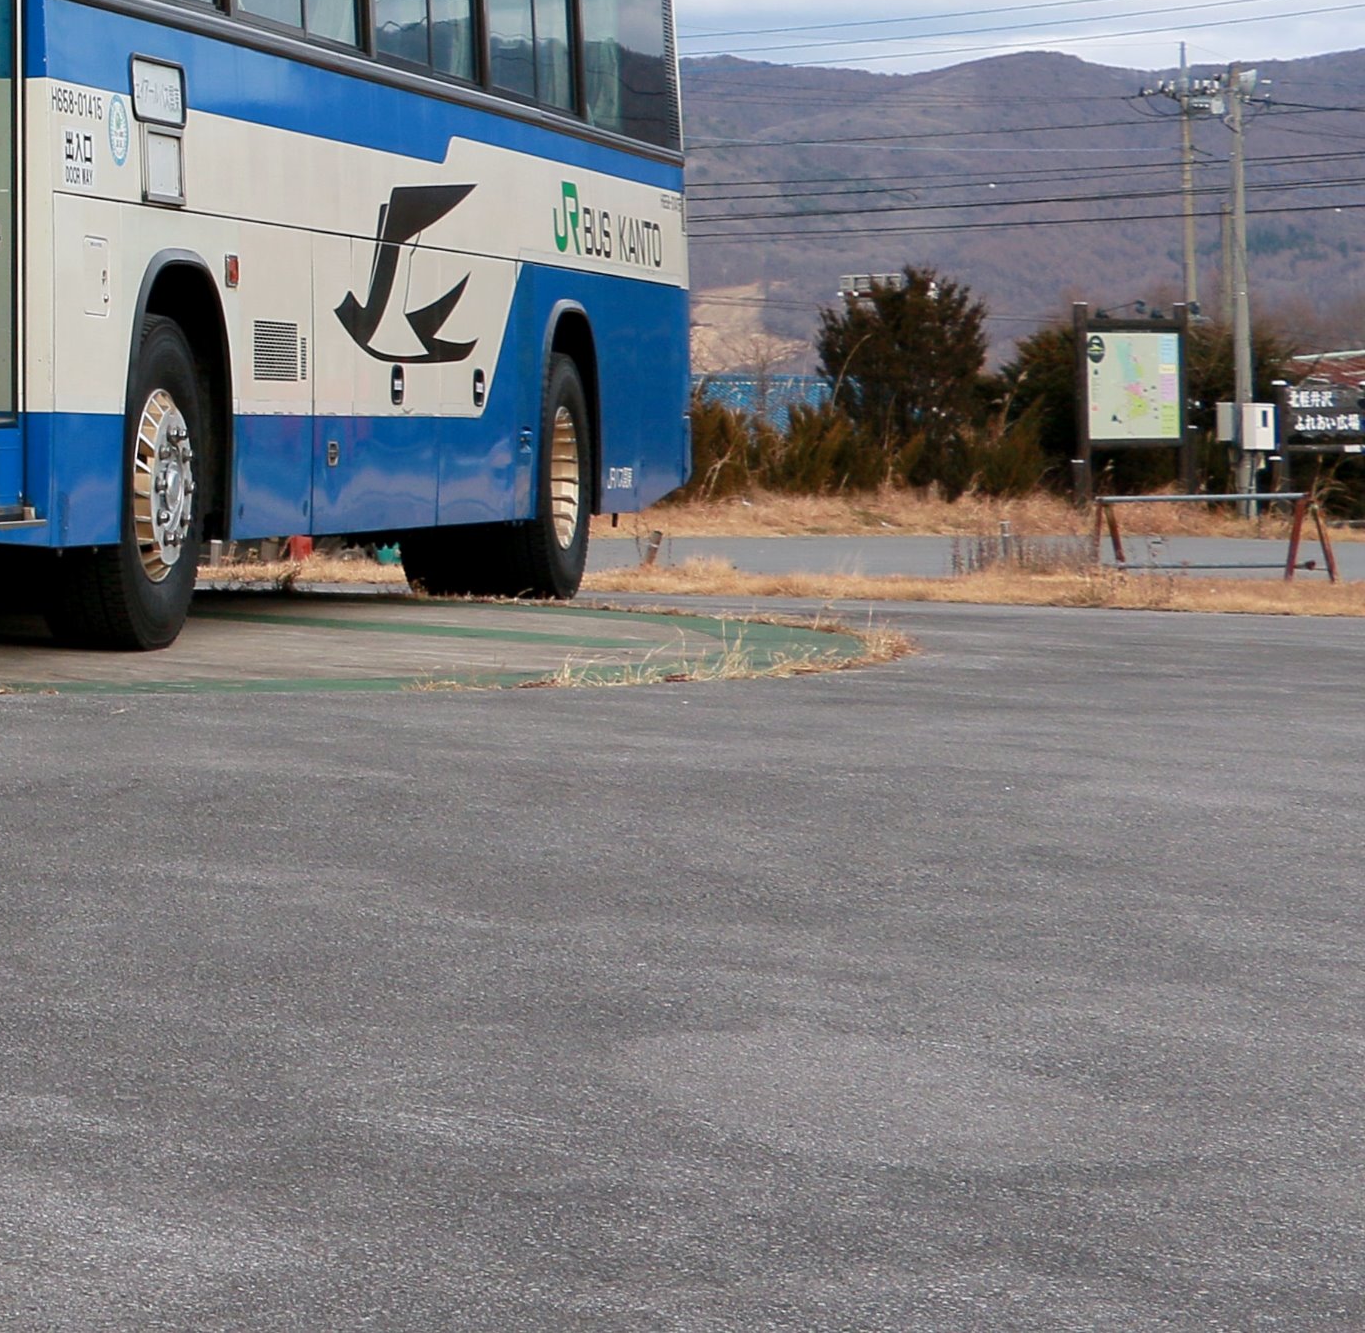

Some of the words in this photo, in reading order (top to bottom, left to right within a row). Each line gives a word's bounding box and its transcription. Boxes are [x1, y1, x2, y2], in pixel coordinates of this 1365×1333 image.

[51, 87, 103, 121] H658-01415
[65, 131, 93, 164] 出入口
[553, 181, 581, 255] JR
[584, 207, 612, 259] BUS
[618, 214, 662, 267] KANTO
[1294, 414, 1361, 431] ふれあい広場
